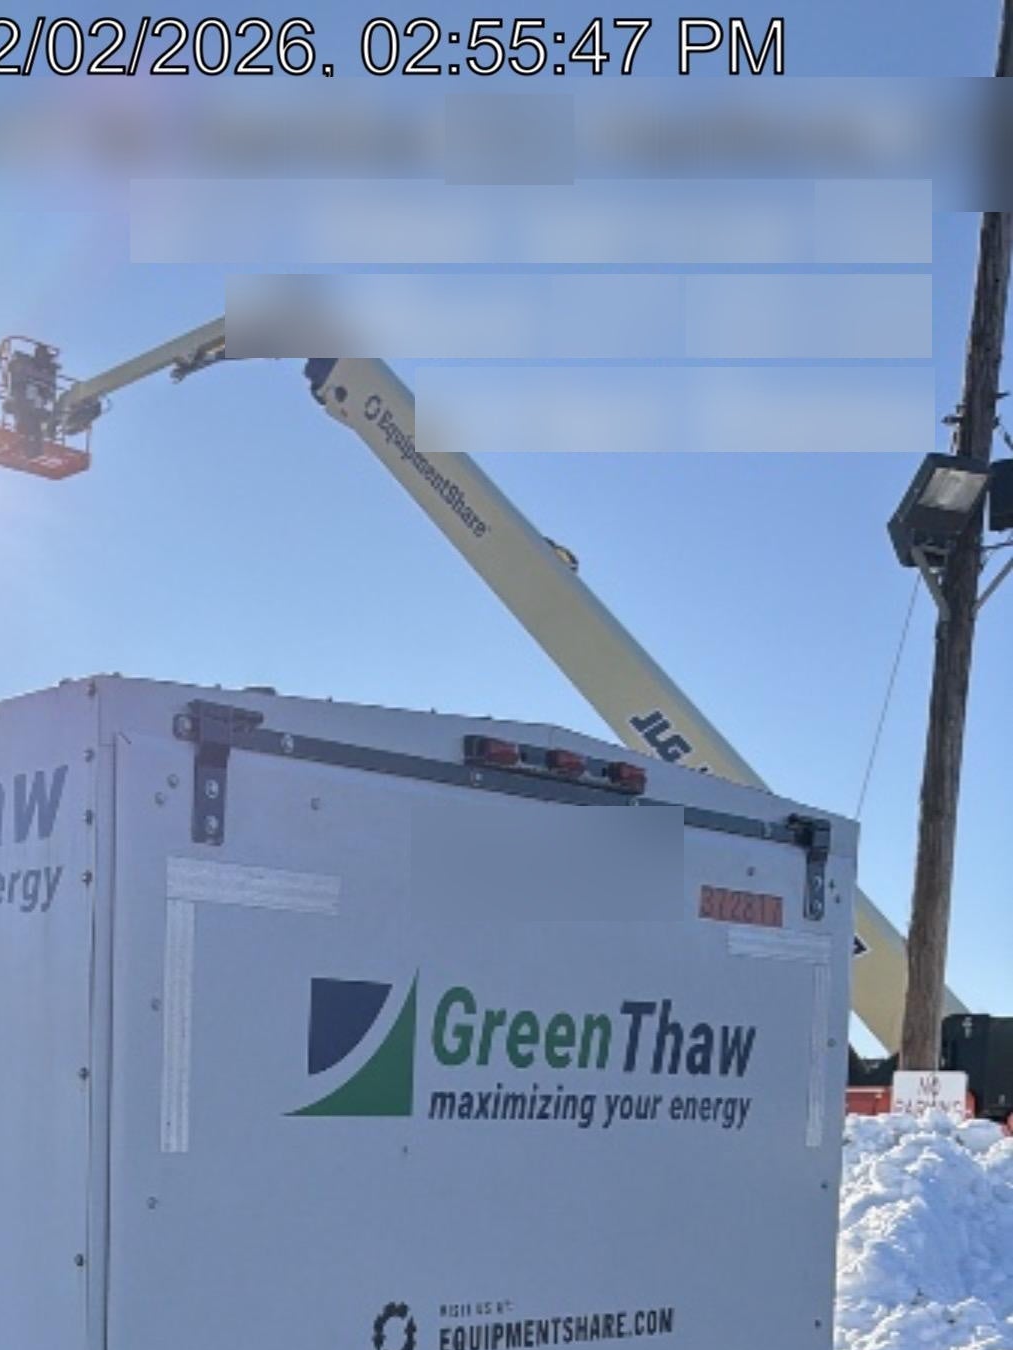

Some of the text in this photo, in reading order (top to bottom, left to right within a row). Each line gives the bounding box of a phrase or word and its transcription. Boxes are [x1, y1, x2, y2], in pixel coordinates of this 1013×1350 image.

[377, 407, 487, 538] EquipmentShare
[629, 710, 693, 763] JLG
[428, 1083, 753, 1130] maximizing your energy
